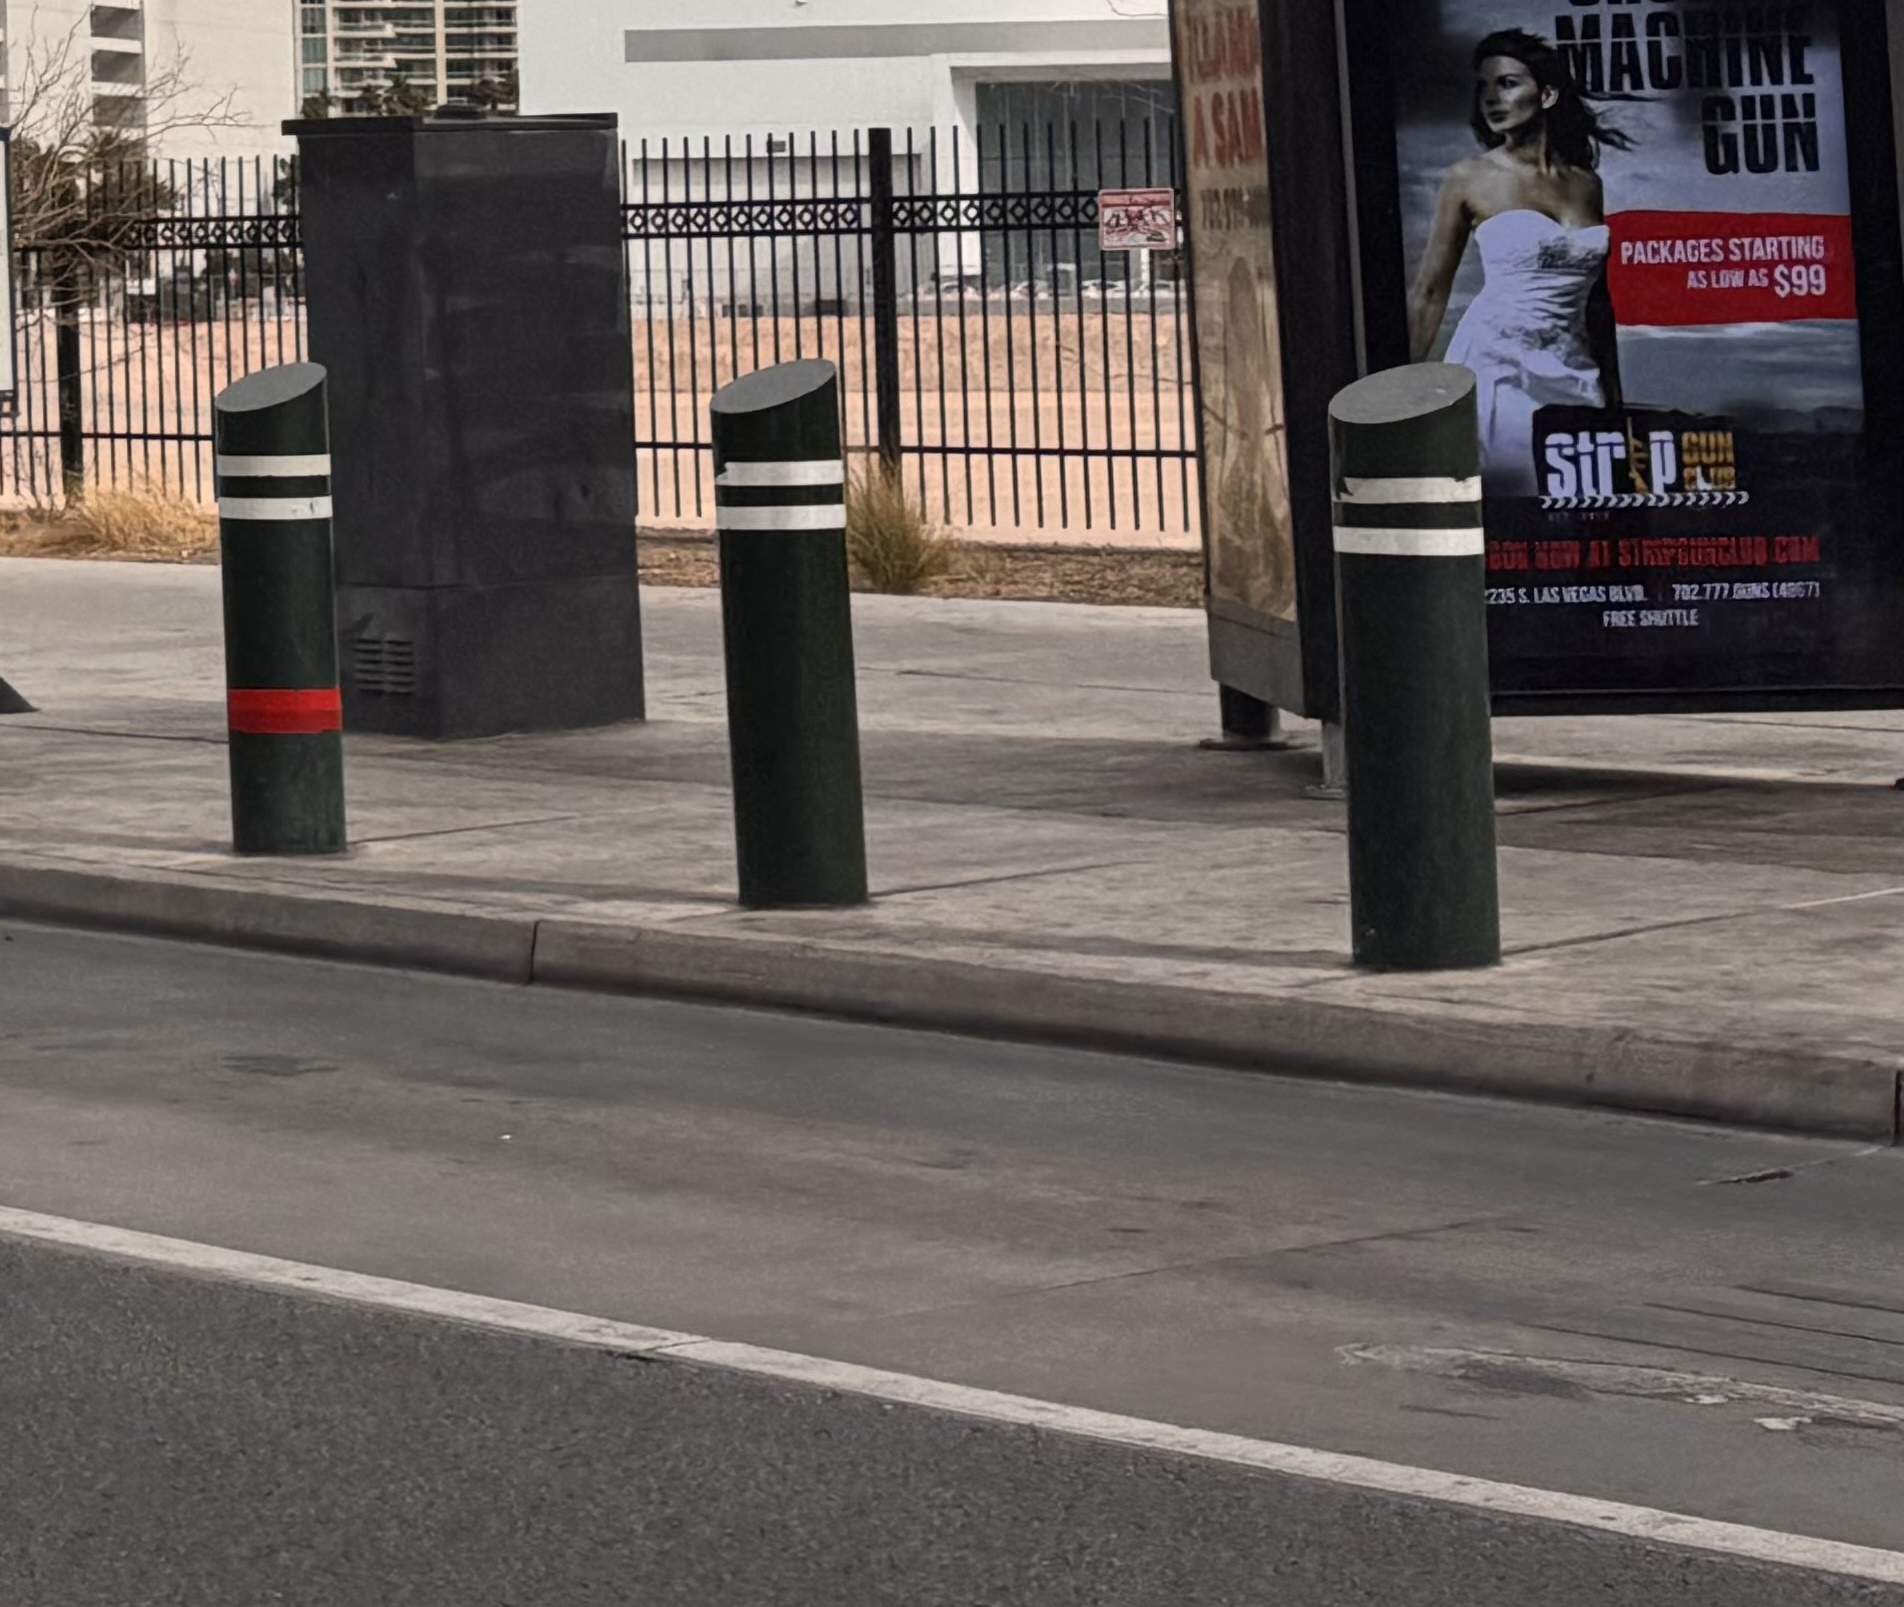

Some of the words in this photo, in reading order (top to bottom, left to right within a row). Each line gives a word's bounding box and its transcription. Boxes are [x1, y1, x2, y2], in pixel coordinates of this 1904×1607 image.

[1555, 6, 1815, 92] MACHINE
[1702, 93, 1820, 175] GUN
[1621, 238, 1725, 264] PACKAGES
[1728, 235, 1825, 262] STARTING
[1687, 270, 1707, 289] AS
[1711, 269, 1745, 288] LOW
[1747, 268, 1769, 287] AS
[1774, 264, 1827, 298] $99
[1682, 432, 1735, 463] GUN
[1534, 585, 1560, 604] LAS
[1561, 584, 1606, 603] VEGAS
[1603, 609, 1637, 628] FREE
[1639, 608, 1700, 627] SHUTTLE
